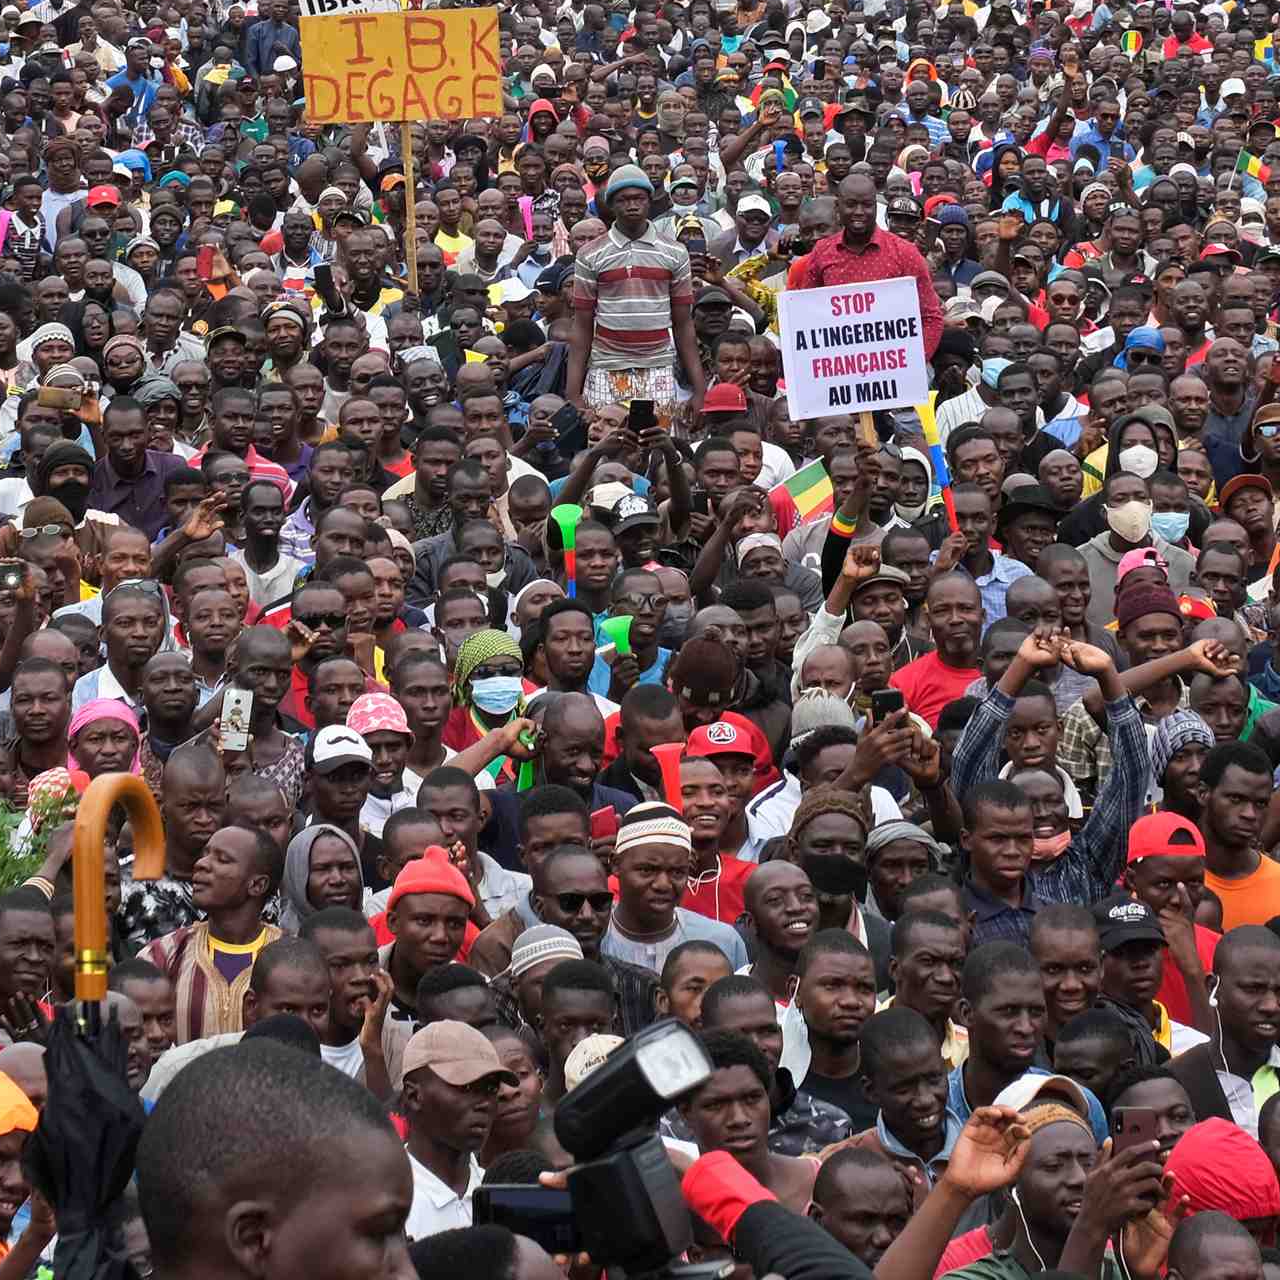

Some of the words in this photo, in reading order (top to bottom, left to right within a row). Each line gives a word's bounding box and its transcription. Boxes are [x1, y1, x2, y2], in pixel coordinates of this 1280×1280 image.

[304, 70, 497, 121] DEGAGE
[830, 292, 875, 317] STOP
[796, 330, 807, 351] A
[811, 317, 918, 349] L'INGERENCE
[812, 348, 908, 379] FRANÇAISE
[828, 385, 851, 407] AU
[856, 380, 898, 403] MALI
